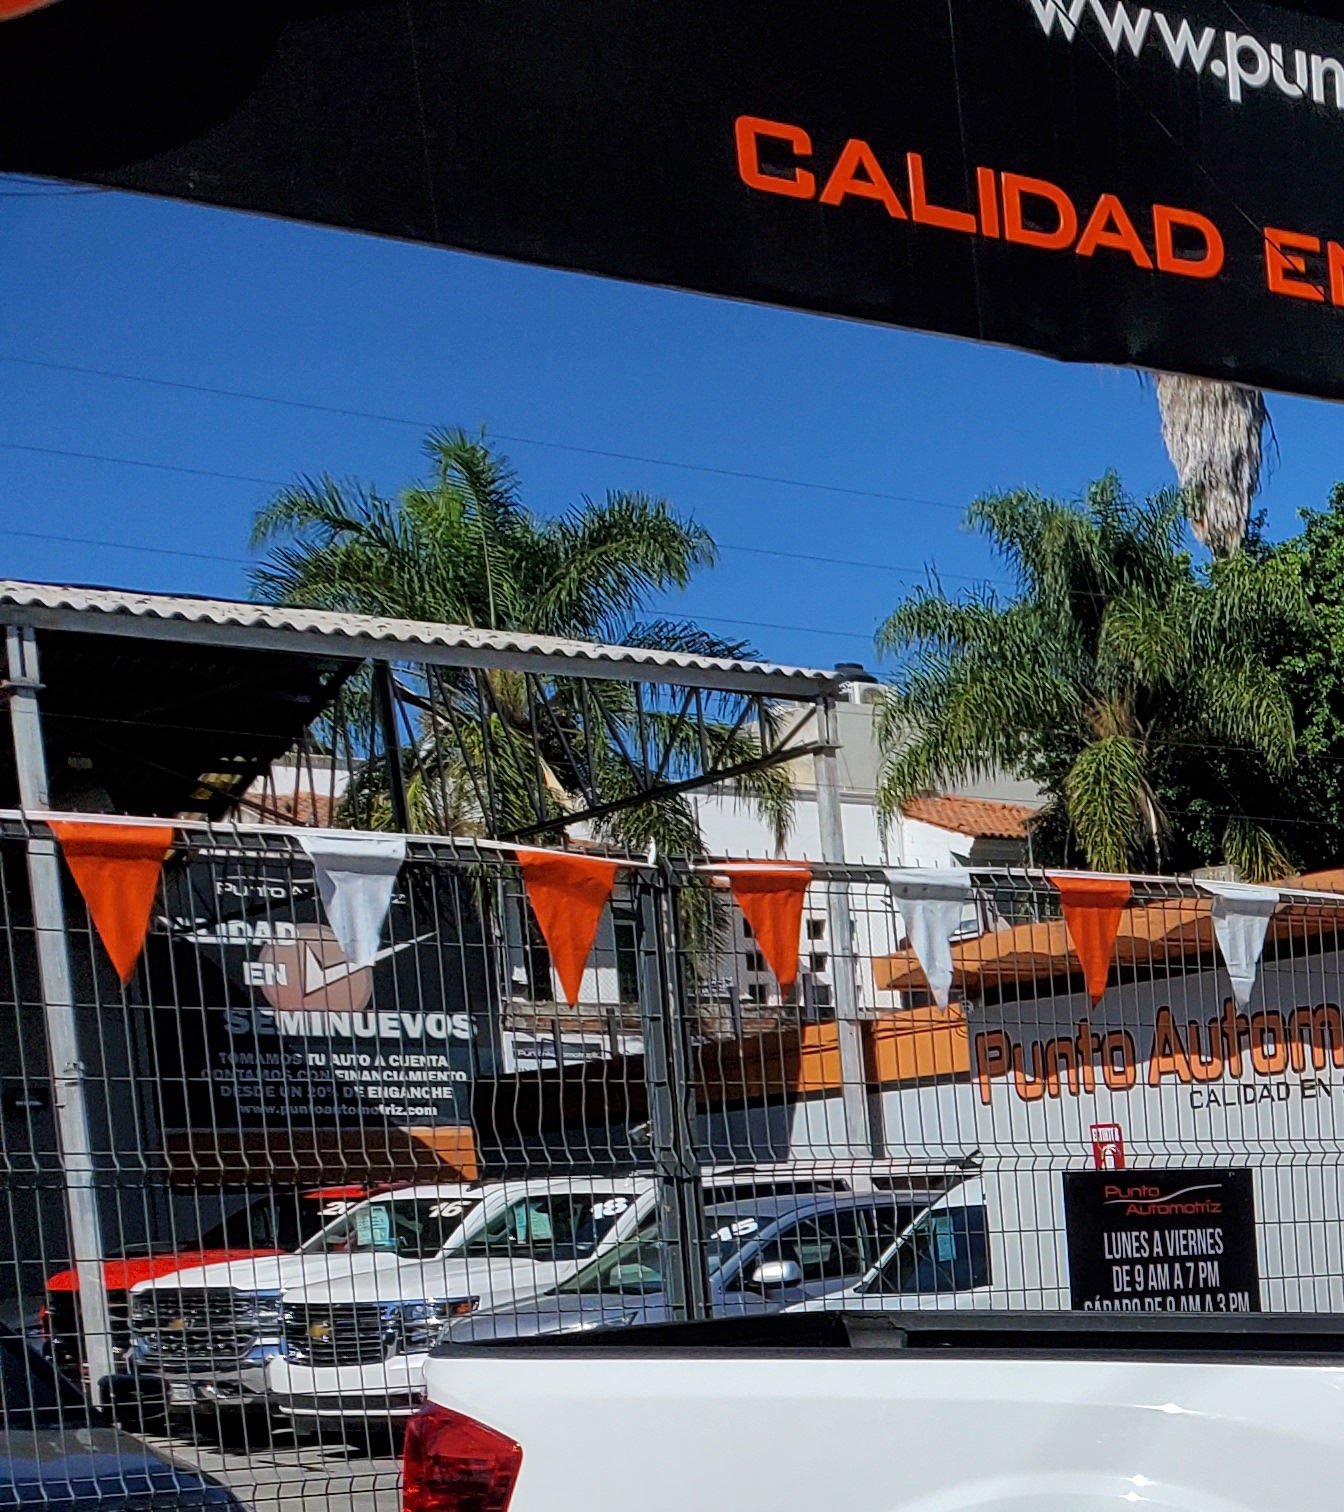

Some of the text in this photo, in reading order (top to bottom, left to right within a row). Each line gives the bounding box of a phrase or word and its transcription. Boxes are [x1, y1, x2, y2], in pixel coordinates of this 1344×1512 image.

[736, 116, 1226, 281] CALIDAD
[243, 961, 287, 987] EN
[223, 1009, 479, 1041] SEMINUEVOS
[218, 1051, 449, 1068] TOMAMOS TU AUTO A CUENTA
[974, 1018, 1138, 1107] Punto
[201, 1068, 467, 1083] CONTAMOS CON FINANCIAMIENTO
[220, 1085, 276, 1098] DESDE
[280, 1085, 303, 1098] UN
[343, 1085, 366, 1099] DE
[368, 1085, 454, 1099] ENGANCHE
[1189, 1081, 1291, 1110] CALIDAD
[1300, 1077, 1331, 1100] EN
[1104, 1184, 1160, 1199] Punto
[590, 1197, 629, 1220] 18
[1125, 1199, 1223, 1216] Automotriz
[710, 1217, 759, 1242] 15
[1103, 1227, 1225, 1260] LUNES A VIERNES
[1112, 1261, 1221, 1293] DE 9 AM A 7 PM
